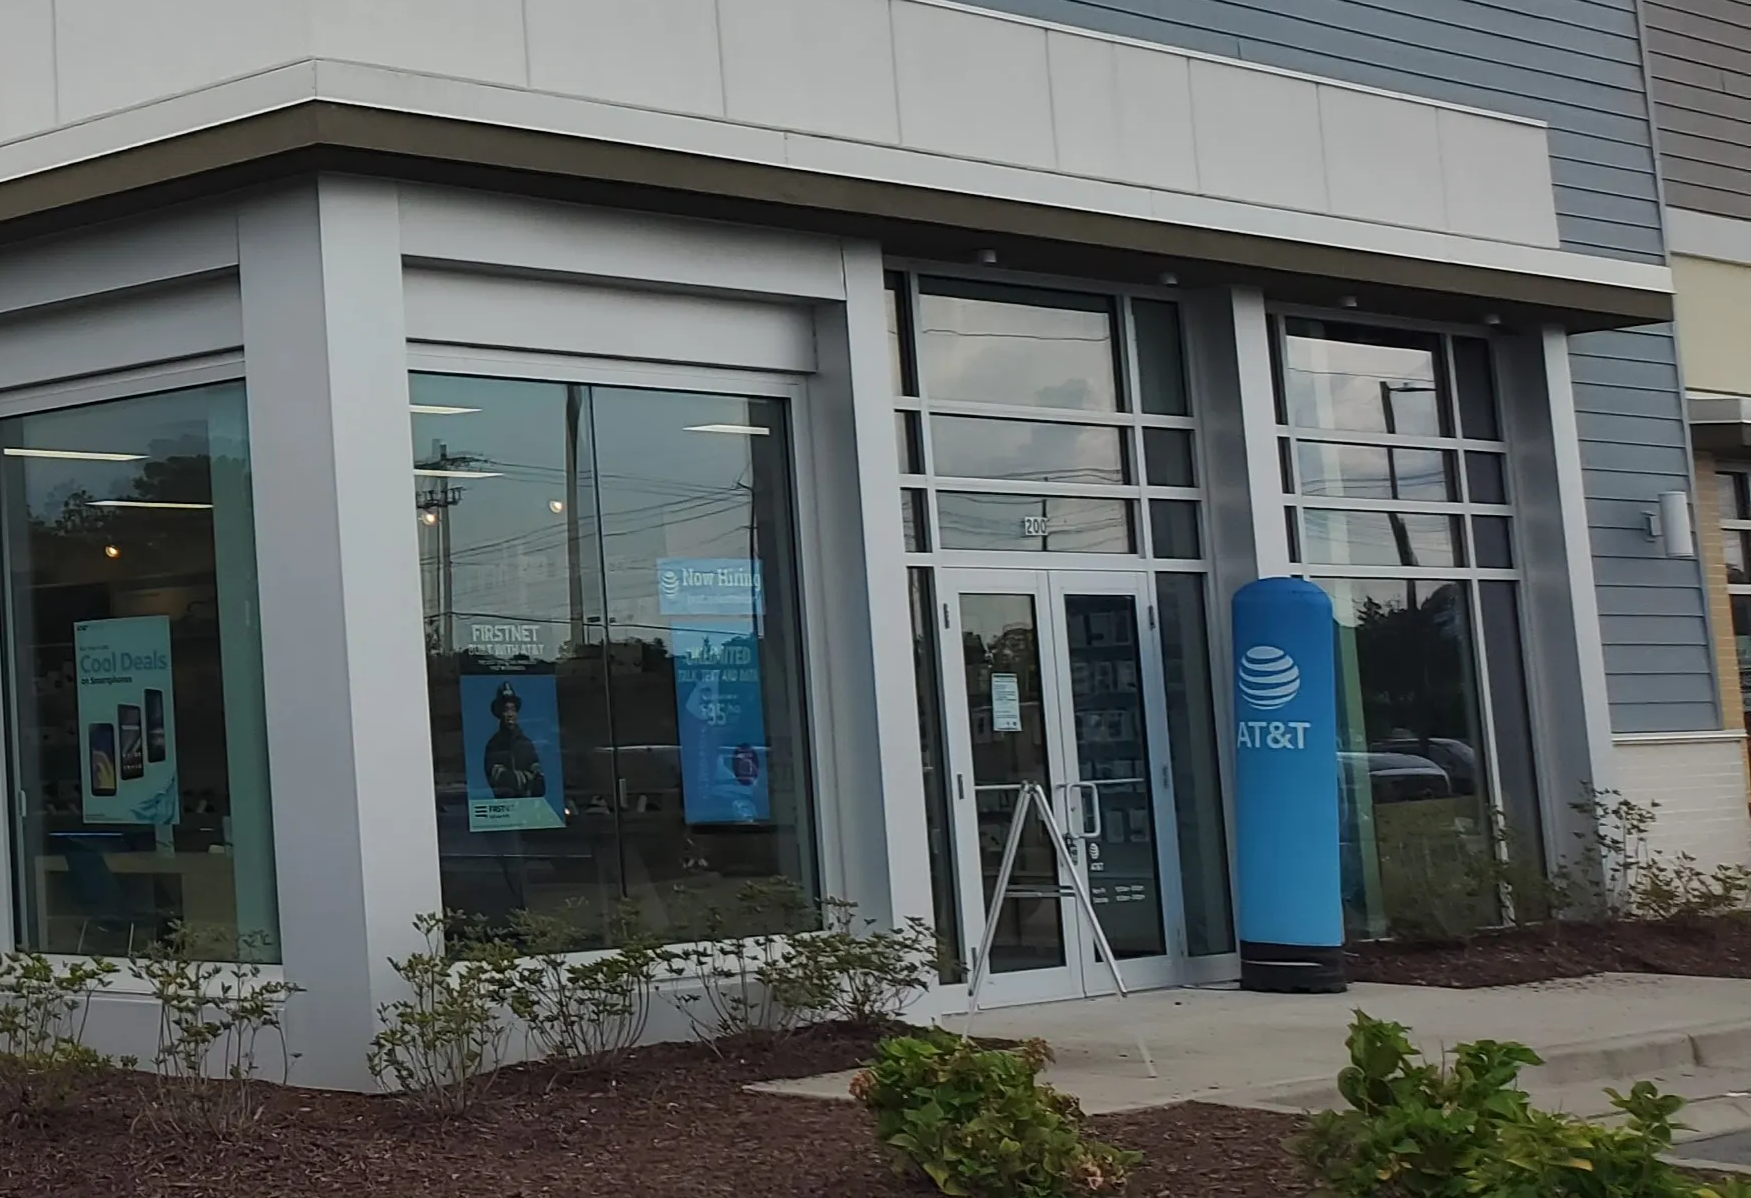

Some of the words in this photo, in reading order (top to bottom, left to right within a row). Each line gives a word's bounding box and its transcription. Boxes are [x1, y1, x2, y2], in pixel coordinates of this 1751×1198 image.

[1026, 518, 1047, 534] 200
[682, 568, 714, 587] Now
[717, 568, 761, 591] Hiring
[471, 624, 540, 642] FIRSTNET
[80, 651, 116, 673] Cool
[121, 649, 168, 671] Deals
[1237, 721, 1311, 750] AT&T
